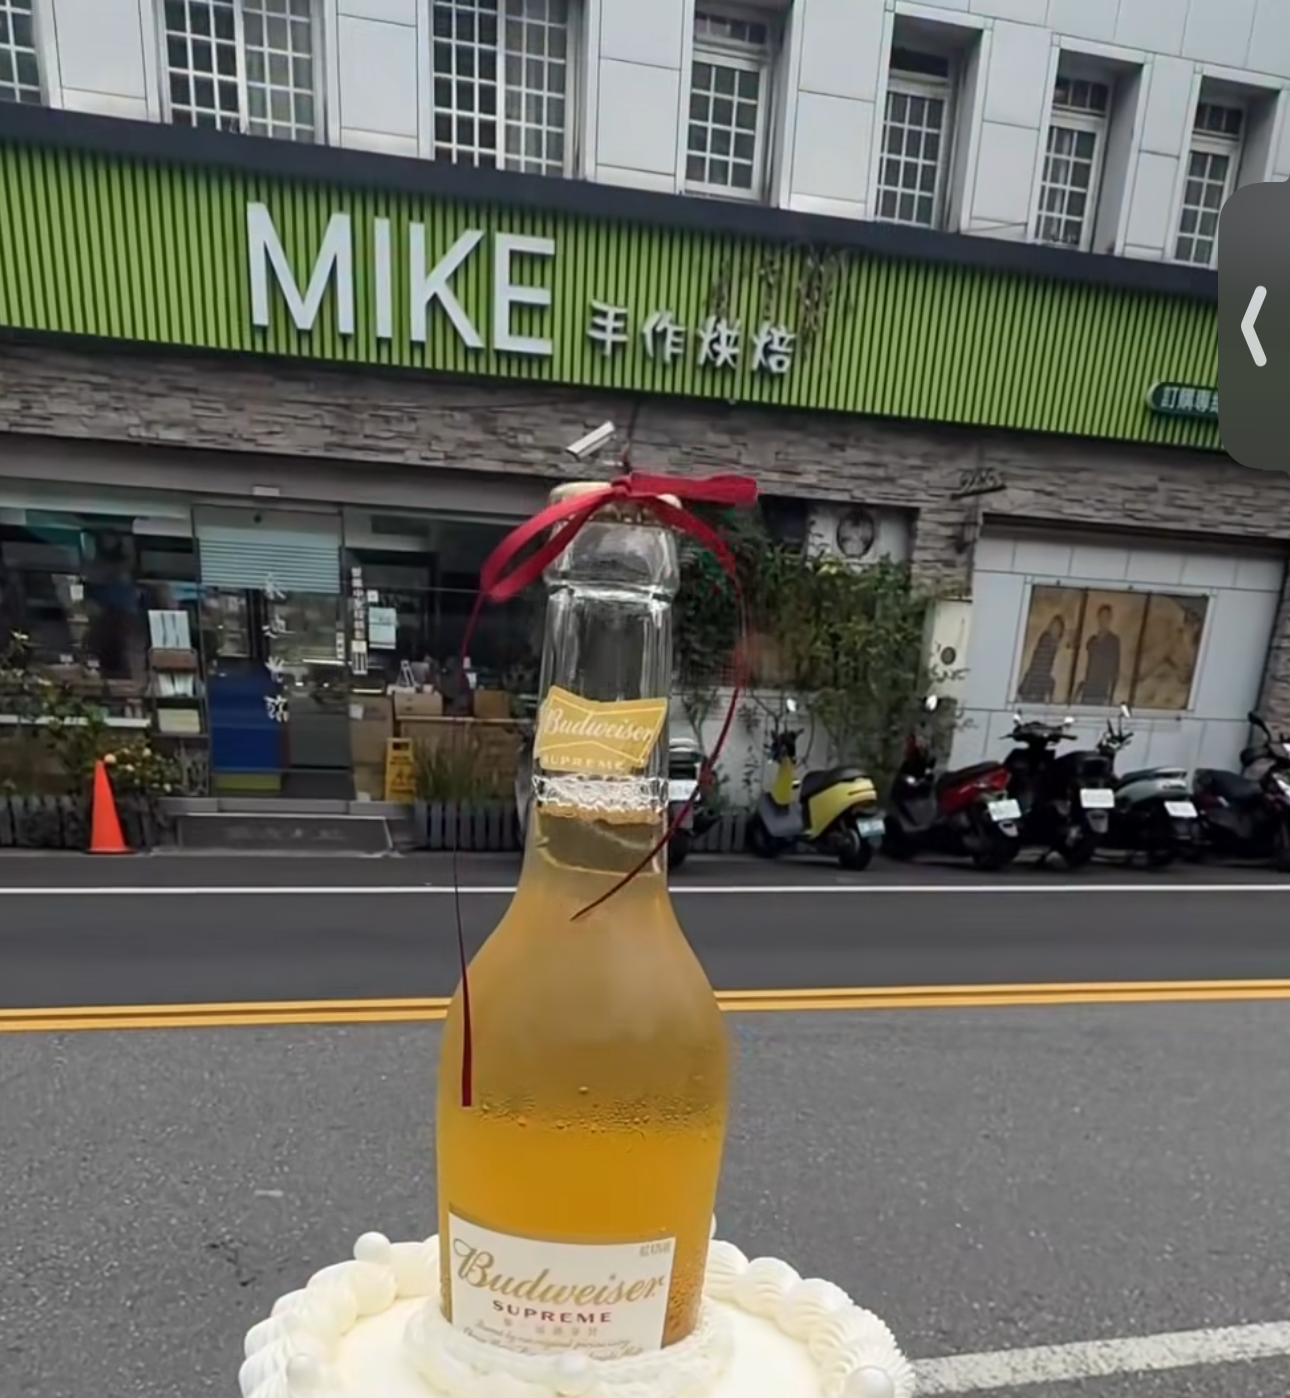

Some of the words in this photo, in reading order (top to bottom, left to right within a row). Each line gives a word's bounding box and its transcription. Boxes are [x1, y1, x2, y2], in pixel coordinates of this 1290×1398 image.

[247, 201, 556, 355] MIKE
[586, 298, 797, 374] 手作烘焙
[544, 707, 654, 741] Budweiser
[453, 1238, 666, 1306] Budweiser
[492, 1300, 613, 1324] SUPREME
